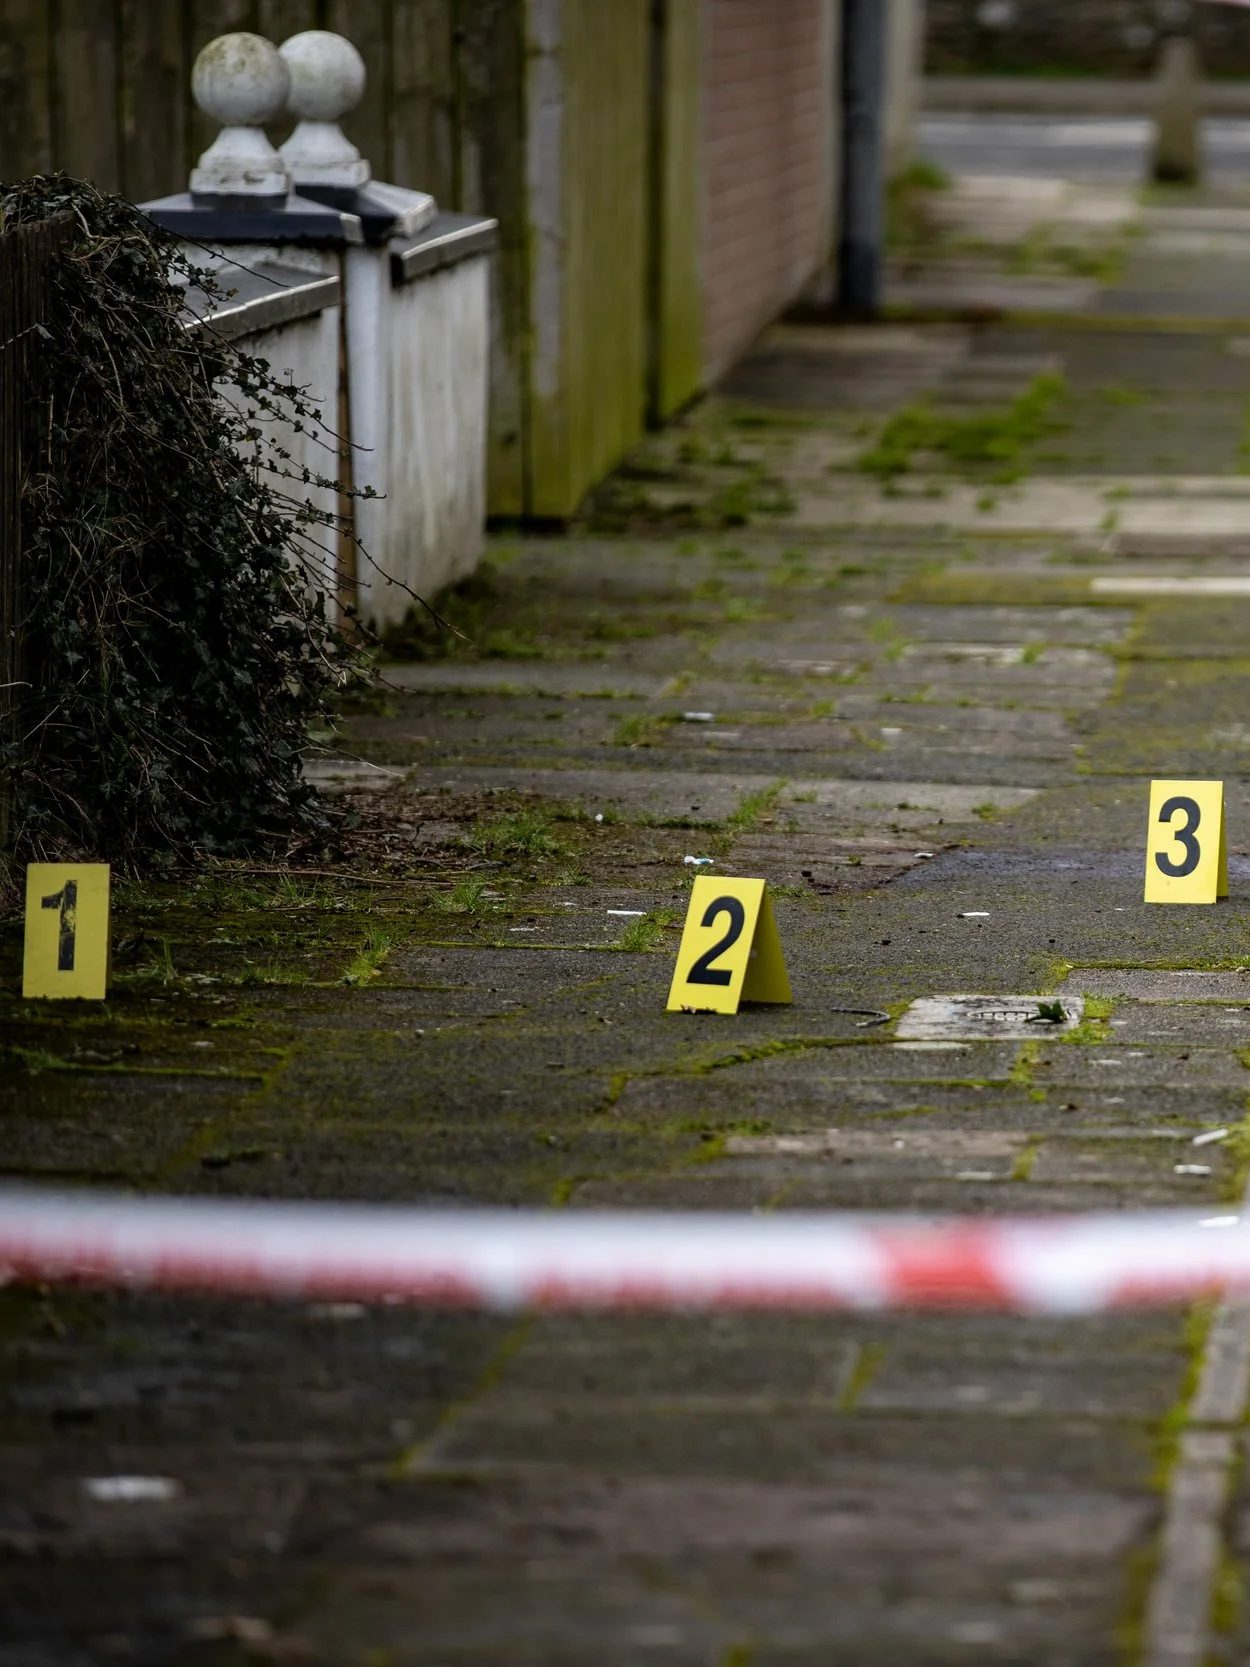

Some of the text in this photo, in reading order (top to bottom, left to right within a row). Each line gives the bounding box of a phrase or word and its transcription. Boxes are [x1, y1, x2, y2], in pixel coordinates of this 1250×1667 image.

[1155, 797, 1201, 878] 3
[41, 879, 78, 971] 1
[686, 896, 745, 986] 2
